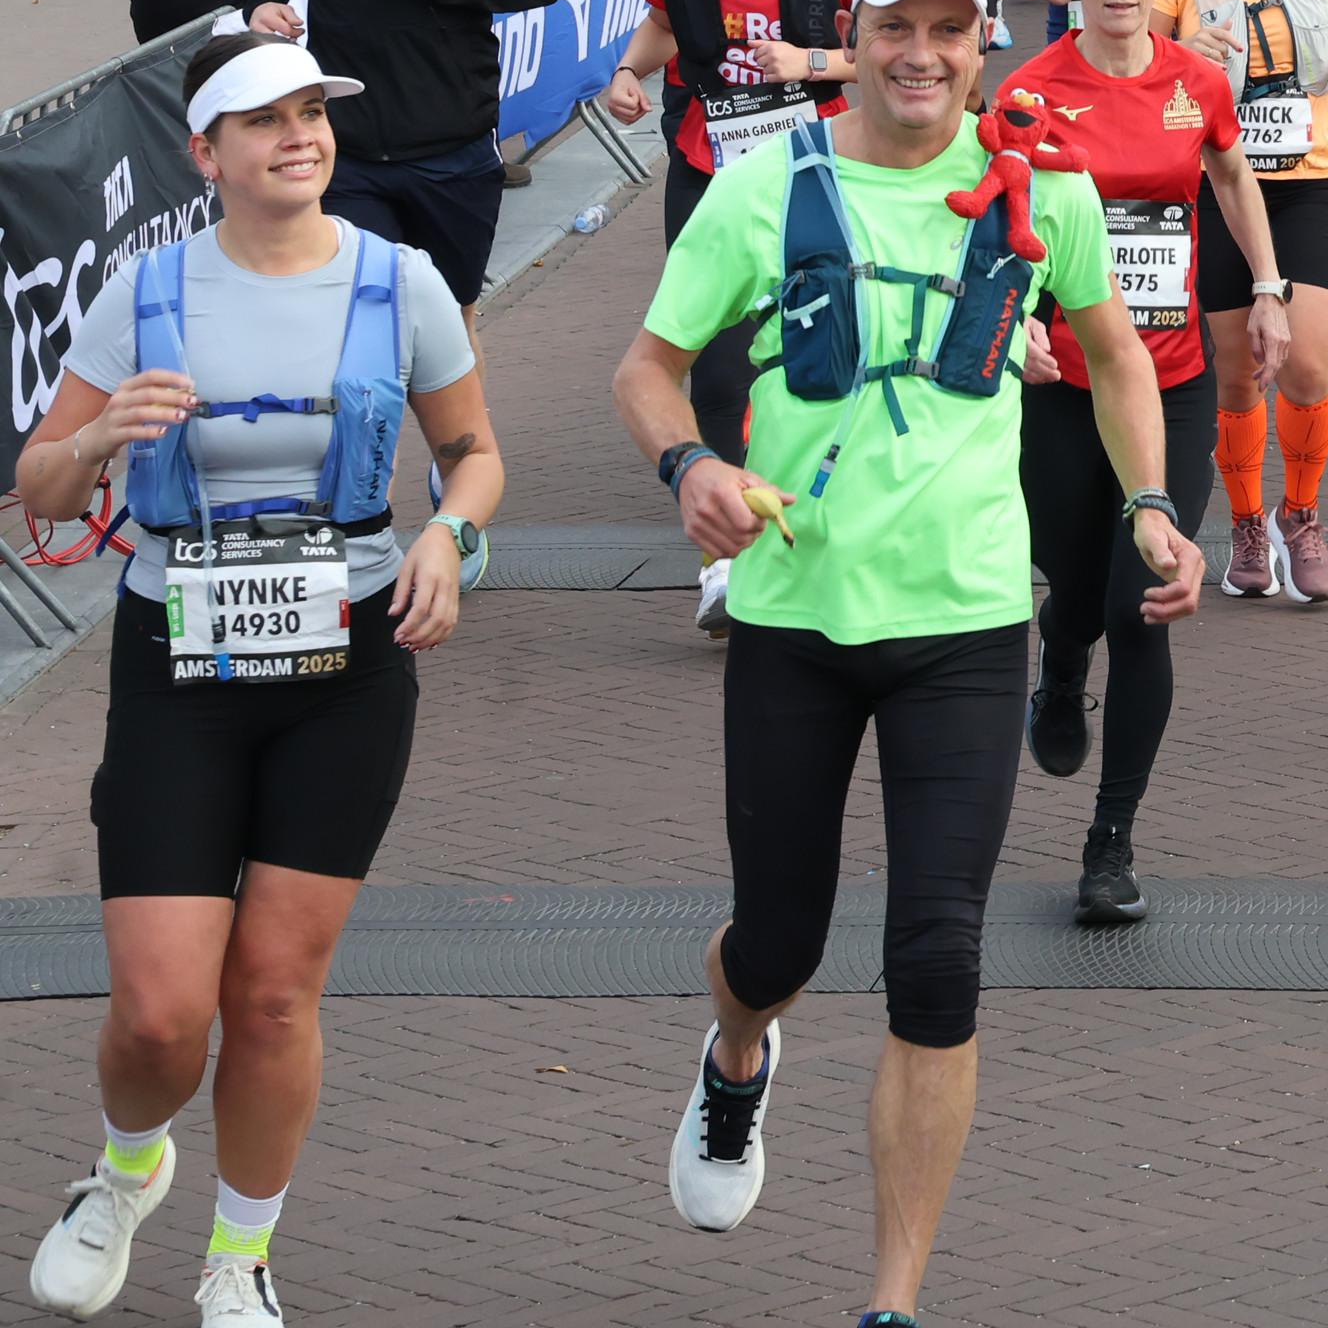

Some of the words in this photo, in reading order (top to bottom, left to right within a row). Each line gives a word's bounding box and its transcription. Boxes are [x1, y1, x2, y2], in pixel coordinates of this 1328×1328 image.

[733, 94, 773, 107] CONSULTANCY
[783, 92, 807, 102] TATA
[707, 99, 732, 117] tcs
[735, 104, 760, 113] SERVICES
[721, 128, 750, 142] ANNA
[1105, 207, 1127, 215] TATA
[1105, 215, 1150, 223] CONSULTANCY
[1160, 222, 1184, 231] TATA
[982, 288, 1018, 379] NATHAN
[222, 533, 249, 541] TATA
[175, 538, 217, 562] tcs
[221, 539, 286, 550] CONSULTANCY
[221, 549, 263, 560] SERVICES
[300, 546, 337, 556] TATA
[213, 576, 307, 606] NYNKE
[297, 652, 346, 675] 2025
